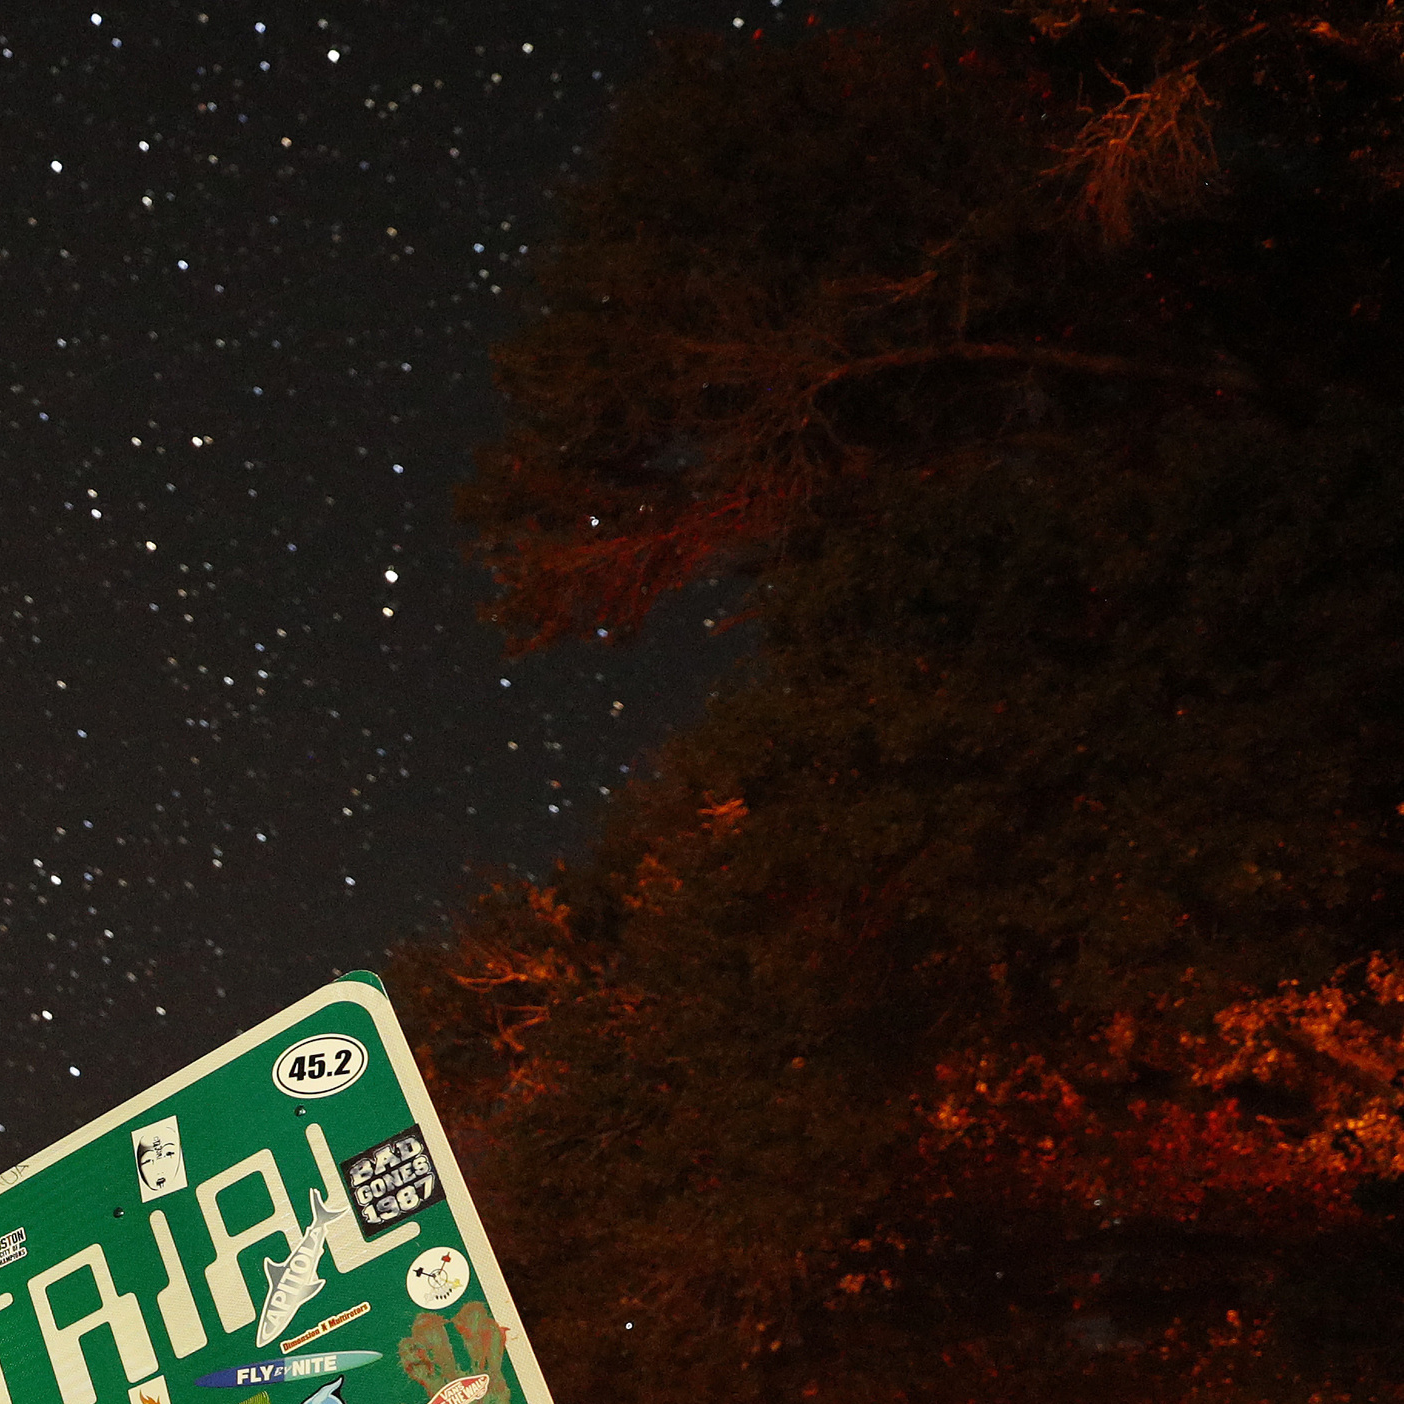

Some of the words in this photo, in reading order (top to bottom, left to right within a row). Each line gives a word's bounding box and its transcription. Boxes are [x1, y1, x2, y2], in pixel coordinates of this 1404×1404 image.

[288, 1049, 352, 1081] 45.2
[349, 1134, 425, 1187] BAD
[355, 1154, 432, 1207] GONES
[361, 1172, 436, 1225] 1987
[283, 1327, 321, 1352] Dimension
[328, 1302, 369, 1328] Multirotors
[236, 1364, 275, 1386] FLY
[291, 1354, 338, 1377] NITE
[439, 1384, 466, 1401] VANS
